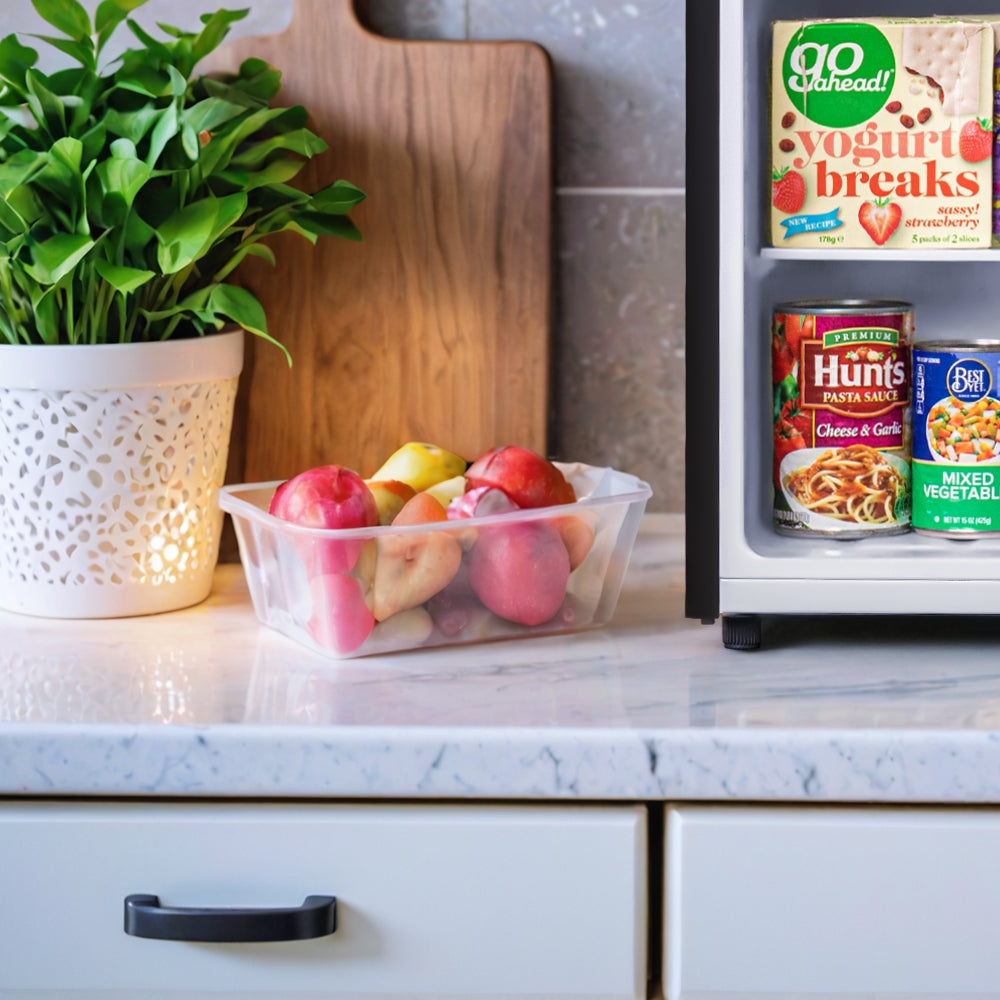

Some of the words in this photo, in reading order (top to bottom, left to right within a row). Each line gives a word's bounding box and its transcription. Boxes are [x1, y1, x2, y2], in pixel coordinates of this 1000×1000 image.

[788, 42, 864, 92] go
[812, 69, 889, 92] ahead!
[793, 121, 959, 169] yogurt
[813, 160, 980, 198] breaks
[937, 203, 980, 217] sassy!
[789, 217, 807, 226] NEW
[805, 219, 837, 231] RECIPE
[905, 216, 980, 230] strawberry
[912, 234, 918, 243] 5
[920, 235, 941, 244] packs
[951, 234, 958, 243] 2
[834, 331, 892, 342] PREMIUM
[823, 391, 861, 403] PASTA
[864, 390, 899, 402] SAUCE
[816, 423, 859, 438] Cheese
[860, 423, 871, 436] &
[873, 421, 902, 436] Garlic
[943, 472, 994, 486] MIXED
